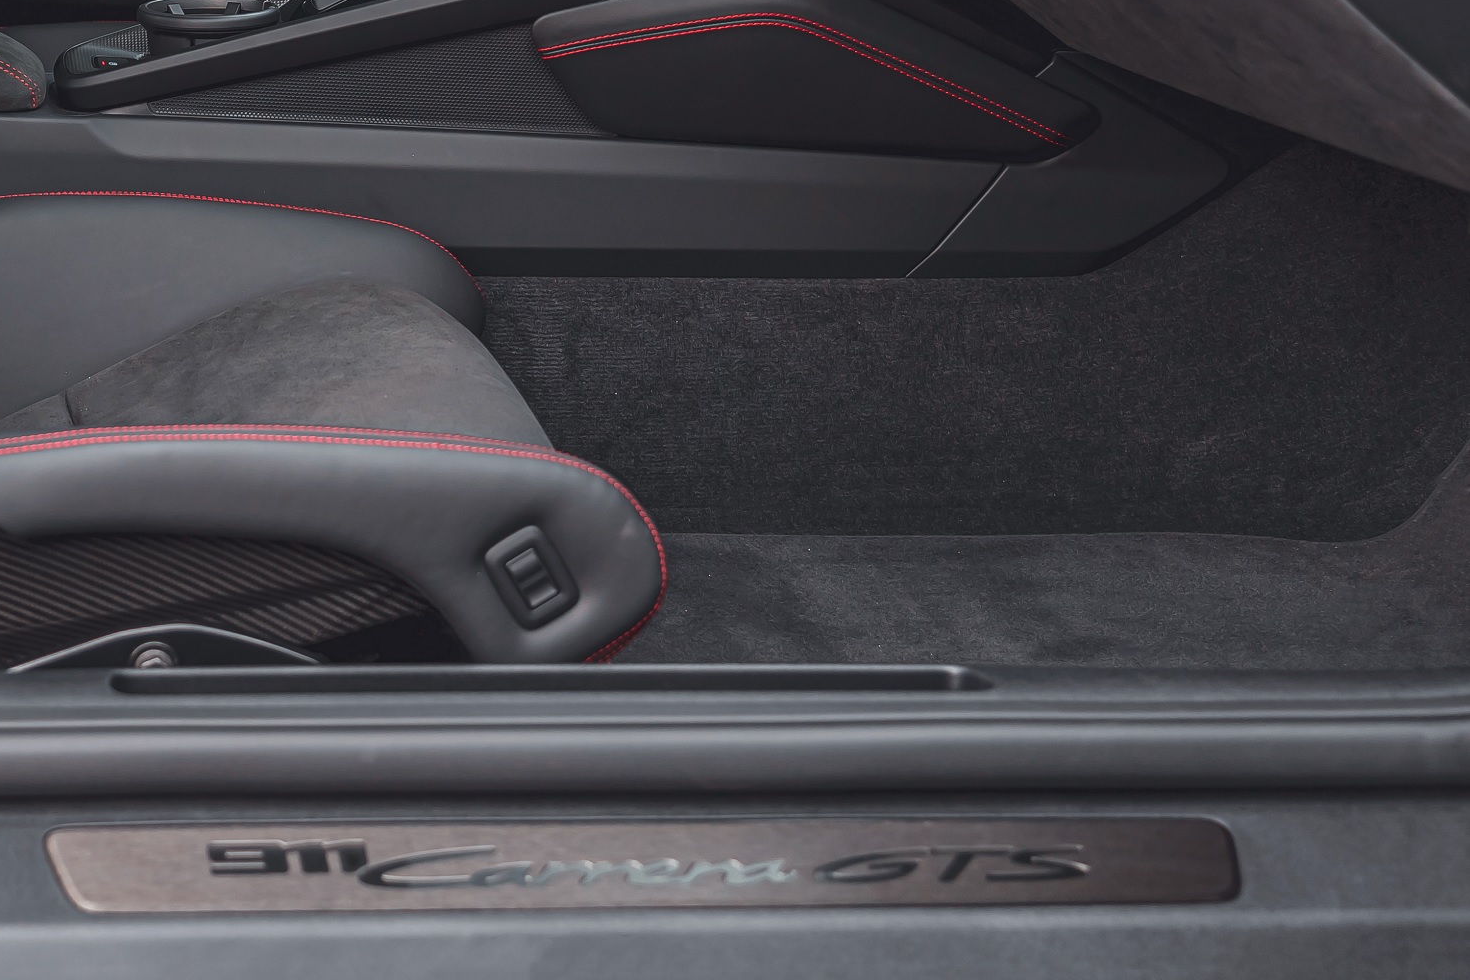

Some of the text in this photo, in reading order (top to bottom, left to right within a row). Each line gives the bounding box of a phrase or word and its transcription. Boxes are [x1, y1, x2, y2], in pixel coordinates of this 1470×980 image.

[207, 837, 1092, 888] 911 Carrera GTS
